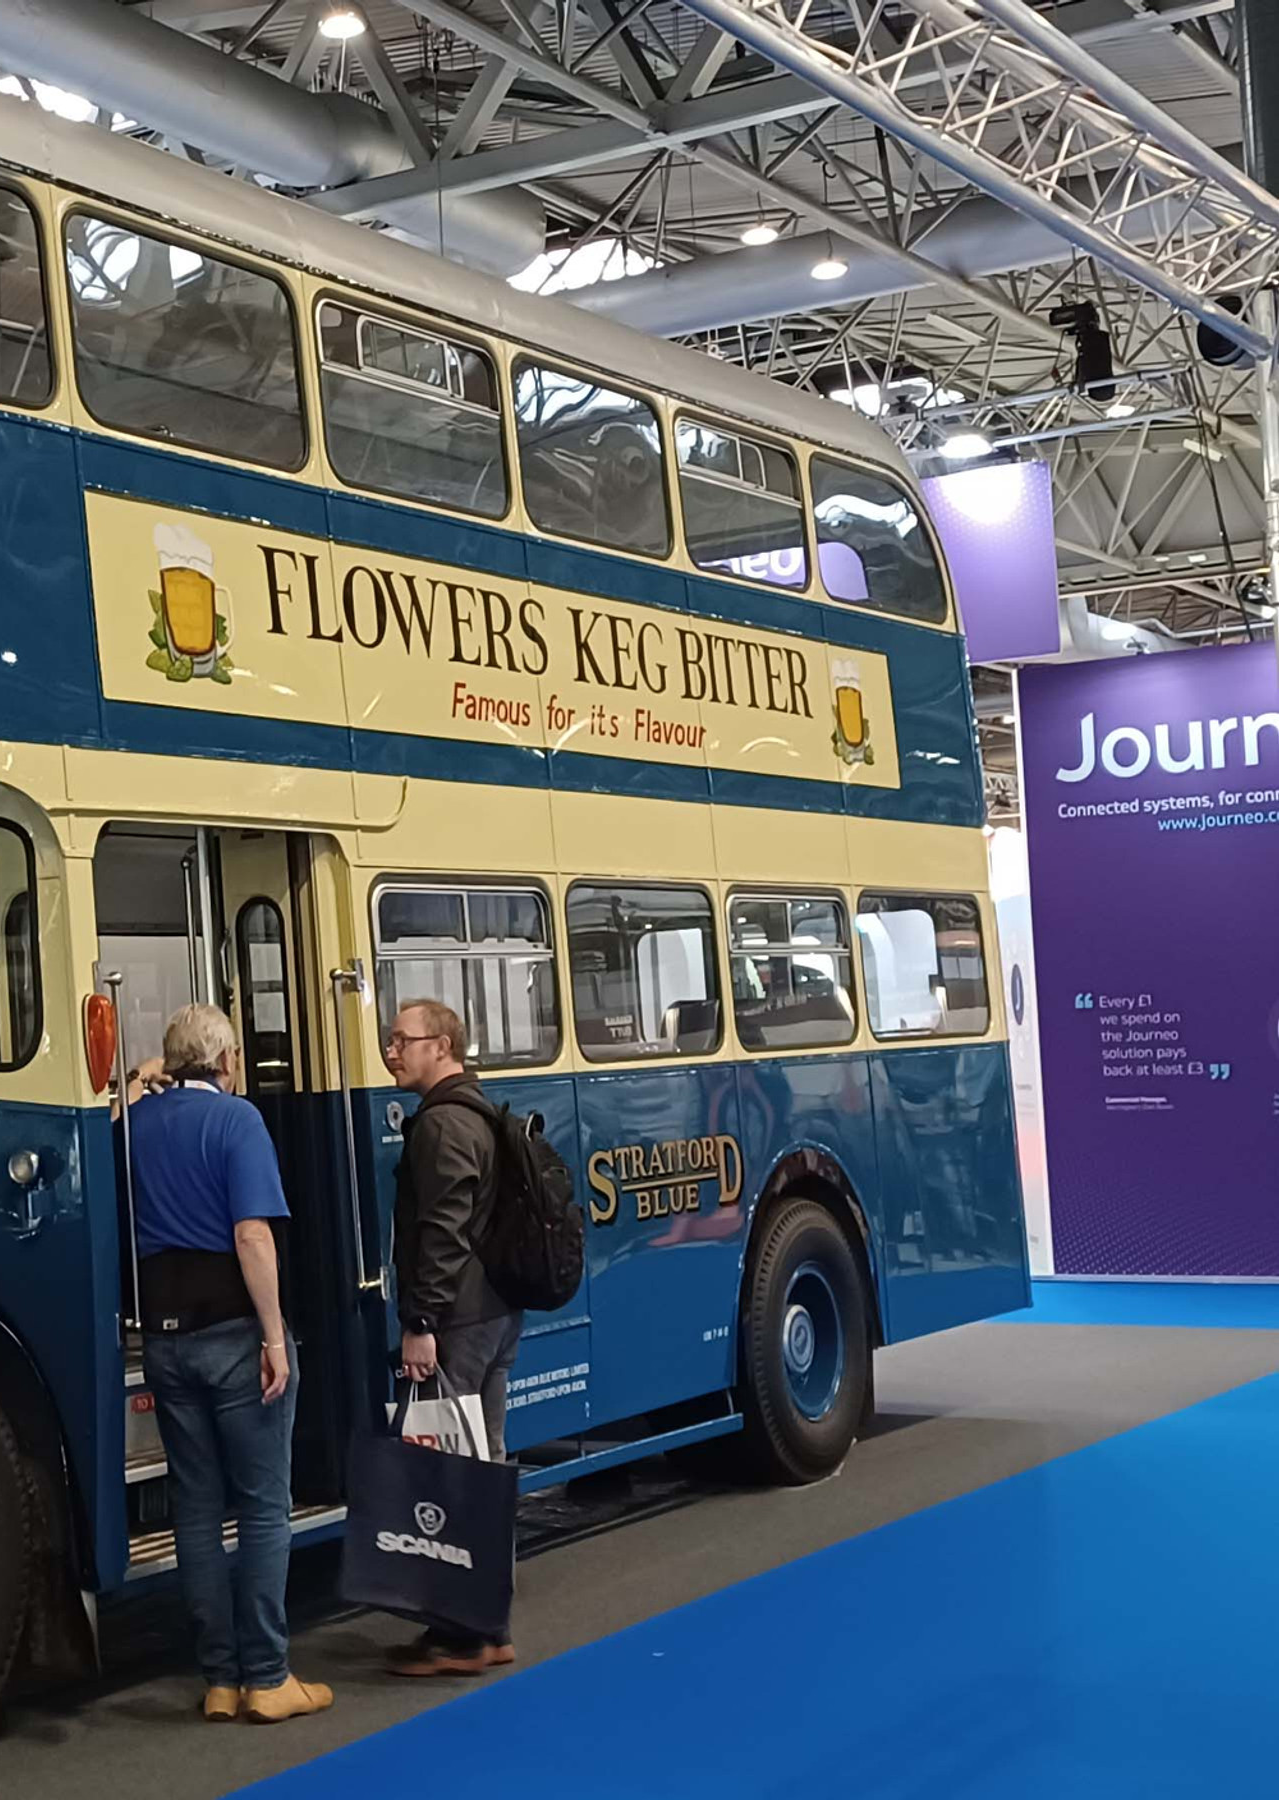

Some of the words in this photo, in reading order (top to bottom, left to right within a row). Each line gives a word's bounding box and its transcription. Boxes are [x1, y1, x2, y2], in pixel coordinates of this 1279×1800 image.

[257, 544, 548, 676] FLOWERS
[566, 607, 668, 693] KEG
[675, 626, 814, 718] BITTER
[451, 682, 531, 727] Famous
[547, 693, 575, 730] for
[634, 708, 707, 748] Flavour
[1058, 798, 1140, 818] Connected
[1143, 794, 1215, 814] systems,
[1218, 790, 1242, 806] for
[1099, 995, 1135, 1009] Every
[1138, 994, 1152, 1007] £1
[1100, 1015, 1119, 1025] we
[1121, 1011, 1161, 1026] spend
[1163, 1013, 1181, 1023] on
[1101, 1031, 1123, 1042] the
[1125, 1030, 1179, 1042] Journeo
[1102, 1047, 1153, 1060] solution
[1156, 1047, 1187, 1060] pays
[1103, 1064, 1134, 1077] back
[1136, 1064, 1150, 1076] at
[1152, 1063, 1184, 1076] least
[588, 1133, 743, 1223] STRATFORD
[636, 1184, 700, 1219] BLUE
[375, 1531, 473, 1569] SCANIA
